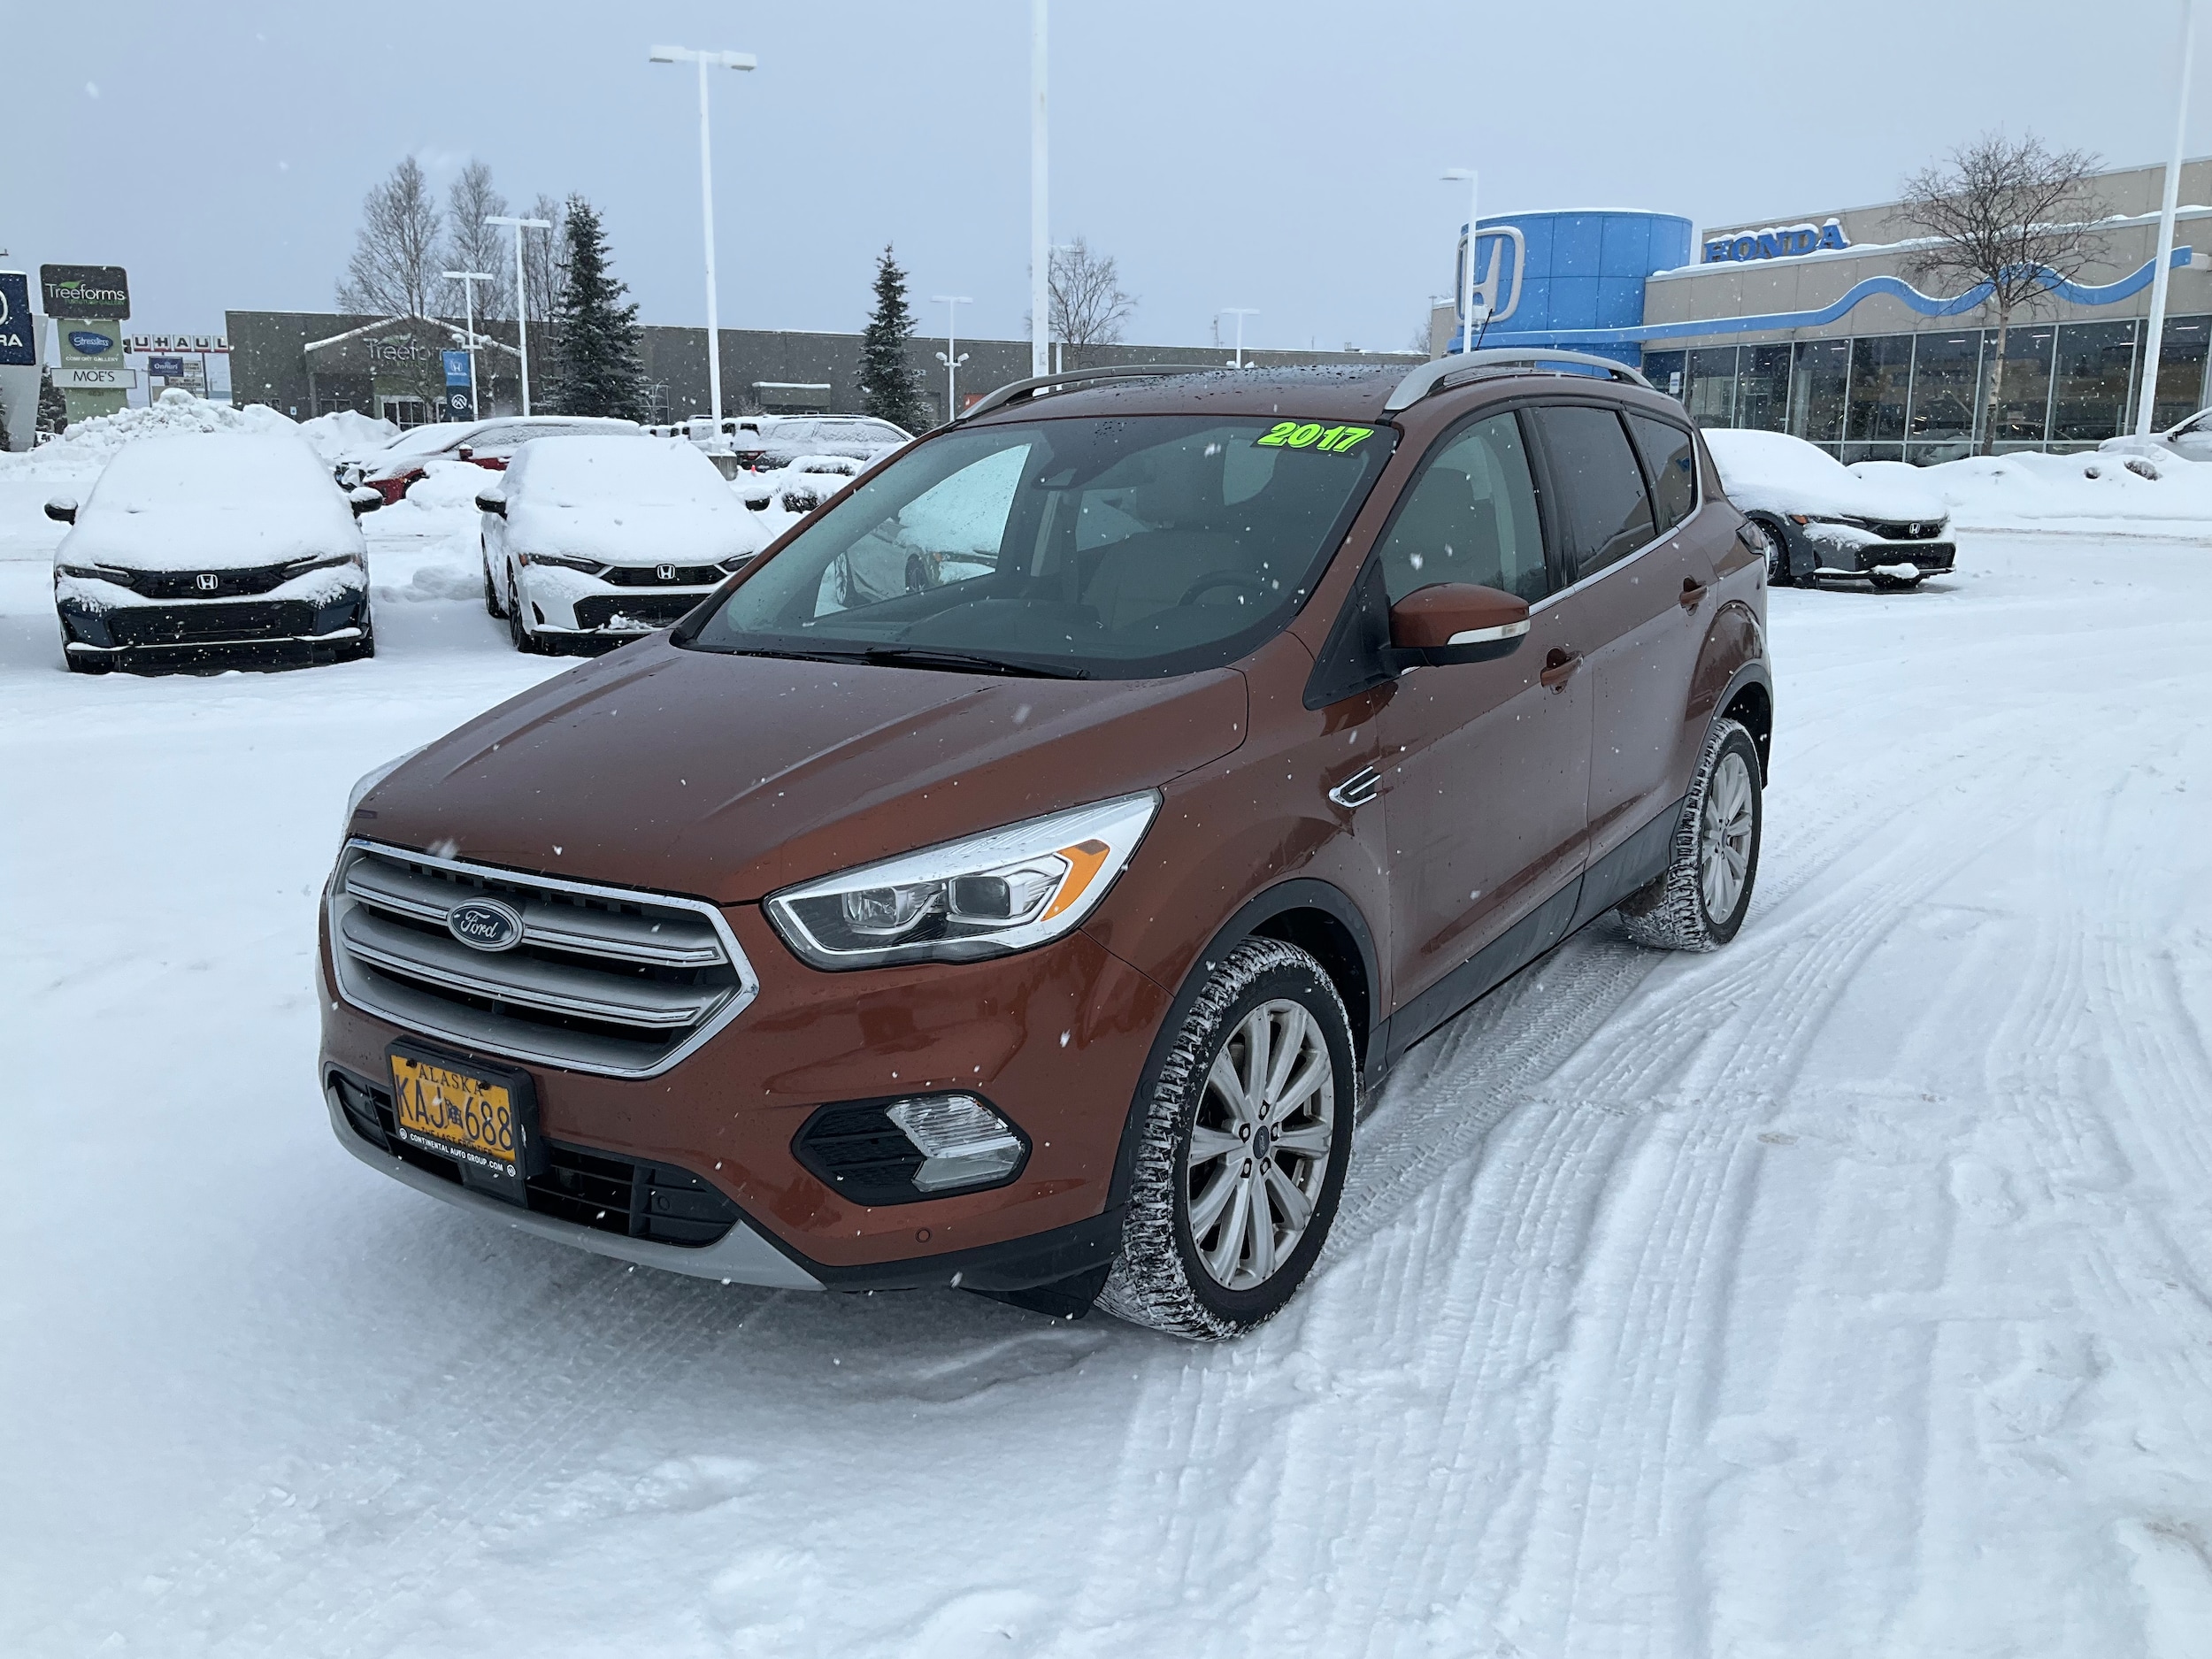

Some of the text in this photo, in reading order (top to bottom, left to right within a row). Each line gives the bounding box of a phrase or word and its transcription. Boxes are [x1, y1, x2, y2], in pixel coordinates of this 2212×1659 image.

[1704, 224, 1847, 263] HONDA
[44, 282, 126, 301] Treeforms
[73, 336, 110, 347] Stressless
[73, 370, 115, 382] MOE'S
[1257, 421, 1375, 453] 2017
[460, 910, 499, 939] Ford
[419, 1064, 484, 1097] ALASKA
[395, 1074, 516, 1151] KAJ 688
[410, 1133, 449, 1154] CONTINENTAL
[449, 1148, 466, 1159] AUTO
[466, 1153, 488, 1166] GROUP
